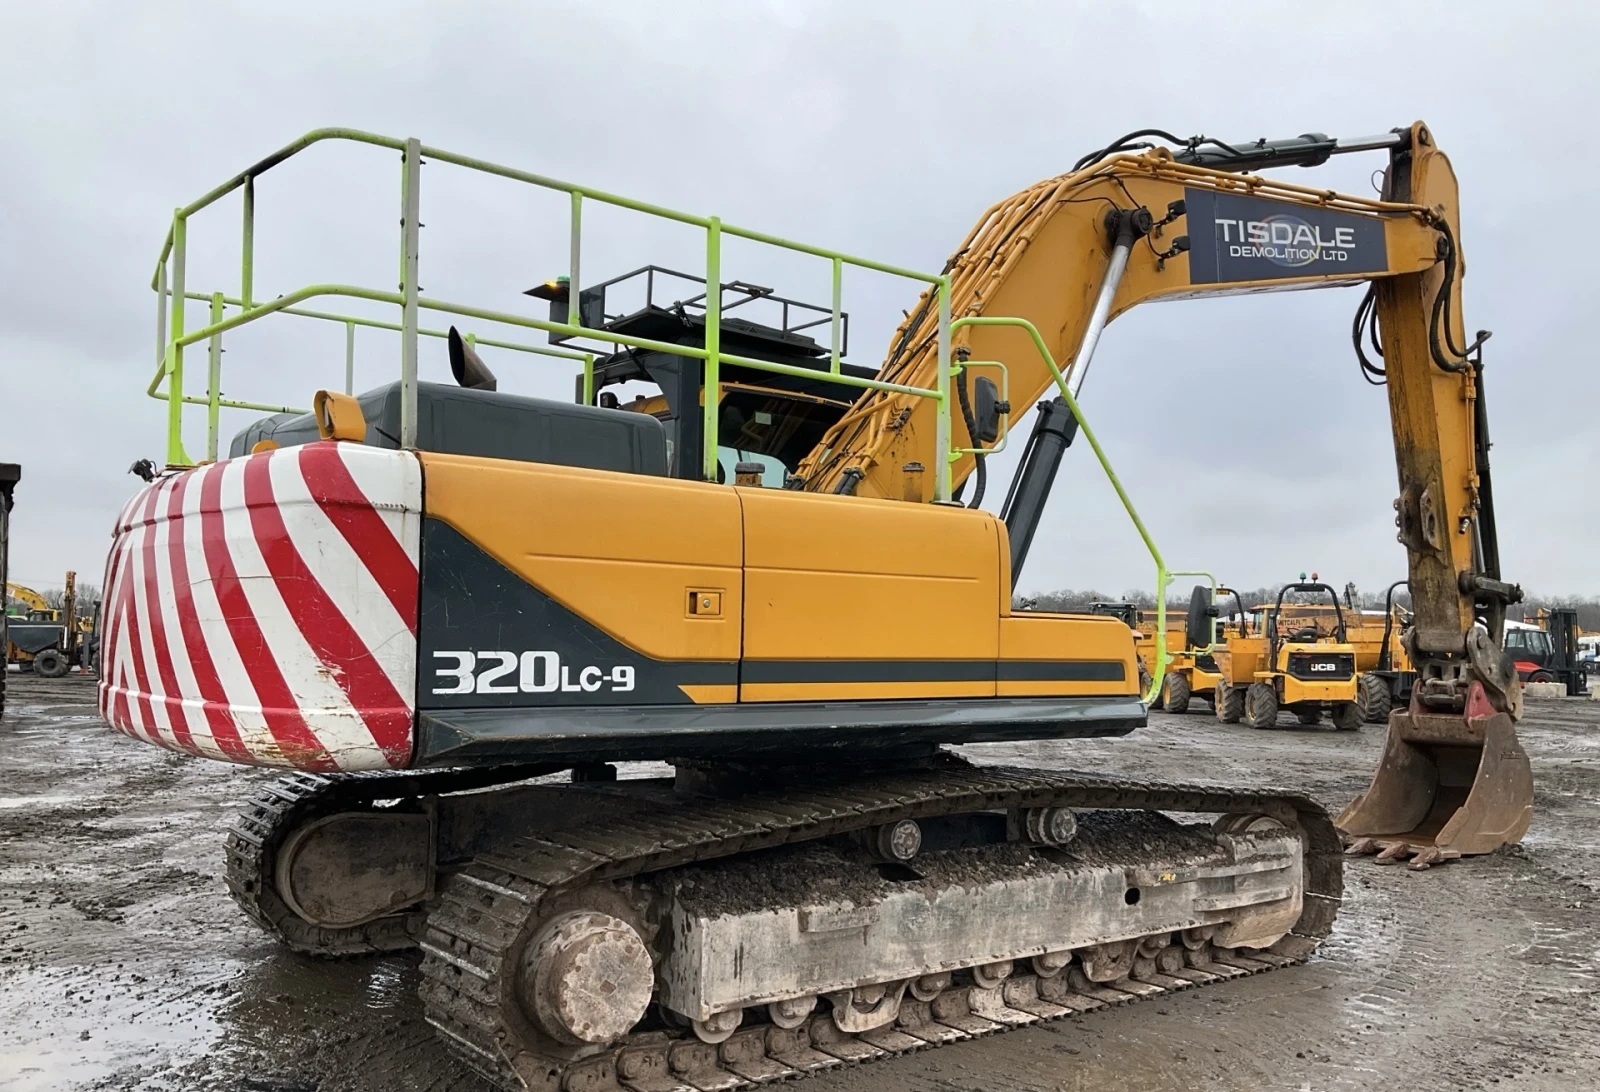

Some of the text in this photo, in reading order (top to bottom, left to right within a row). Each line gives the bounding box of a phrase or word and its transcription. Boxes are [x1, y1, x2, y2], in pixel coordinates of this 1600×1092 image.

[1215, 218, 1356, 249] TISDALE
[1229, 245, 1348, 261] DEMOLITION LTD
[1310, 663, 1336, 672] JCB
